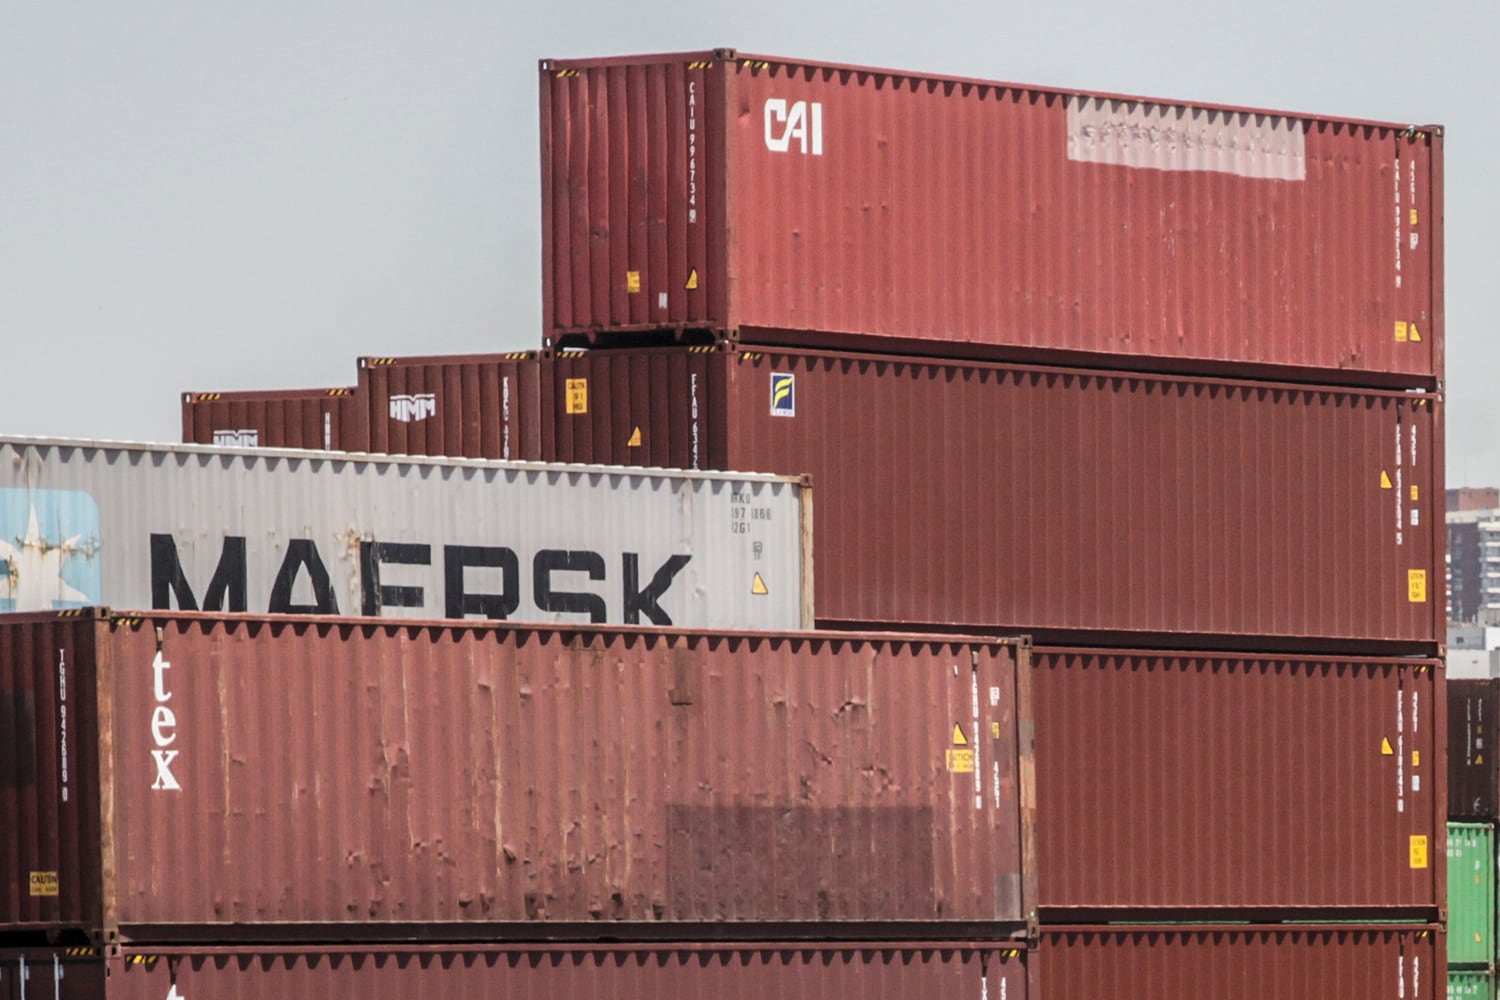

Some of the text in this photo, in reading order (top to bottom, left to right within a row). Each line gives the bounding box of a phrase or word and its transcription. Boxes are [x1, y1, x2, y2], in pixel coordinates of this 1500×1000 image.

[764, 98, 823, 156] CAI
[390, 393, 435, 422] HMM
[150, 533, 693, 626] MAERSK
[151, 650, 181, 791] tex
